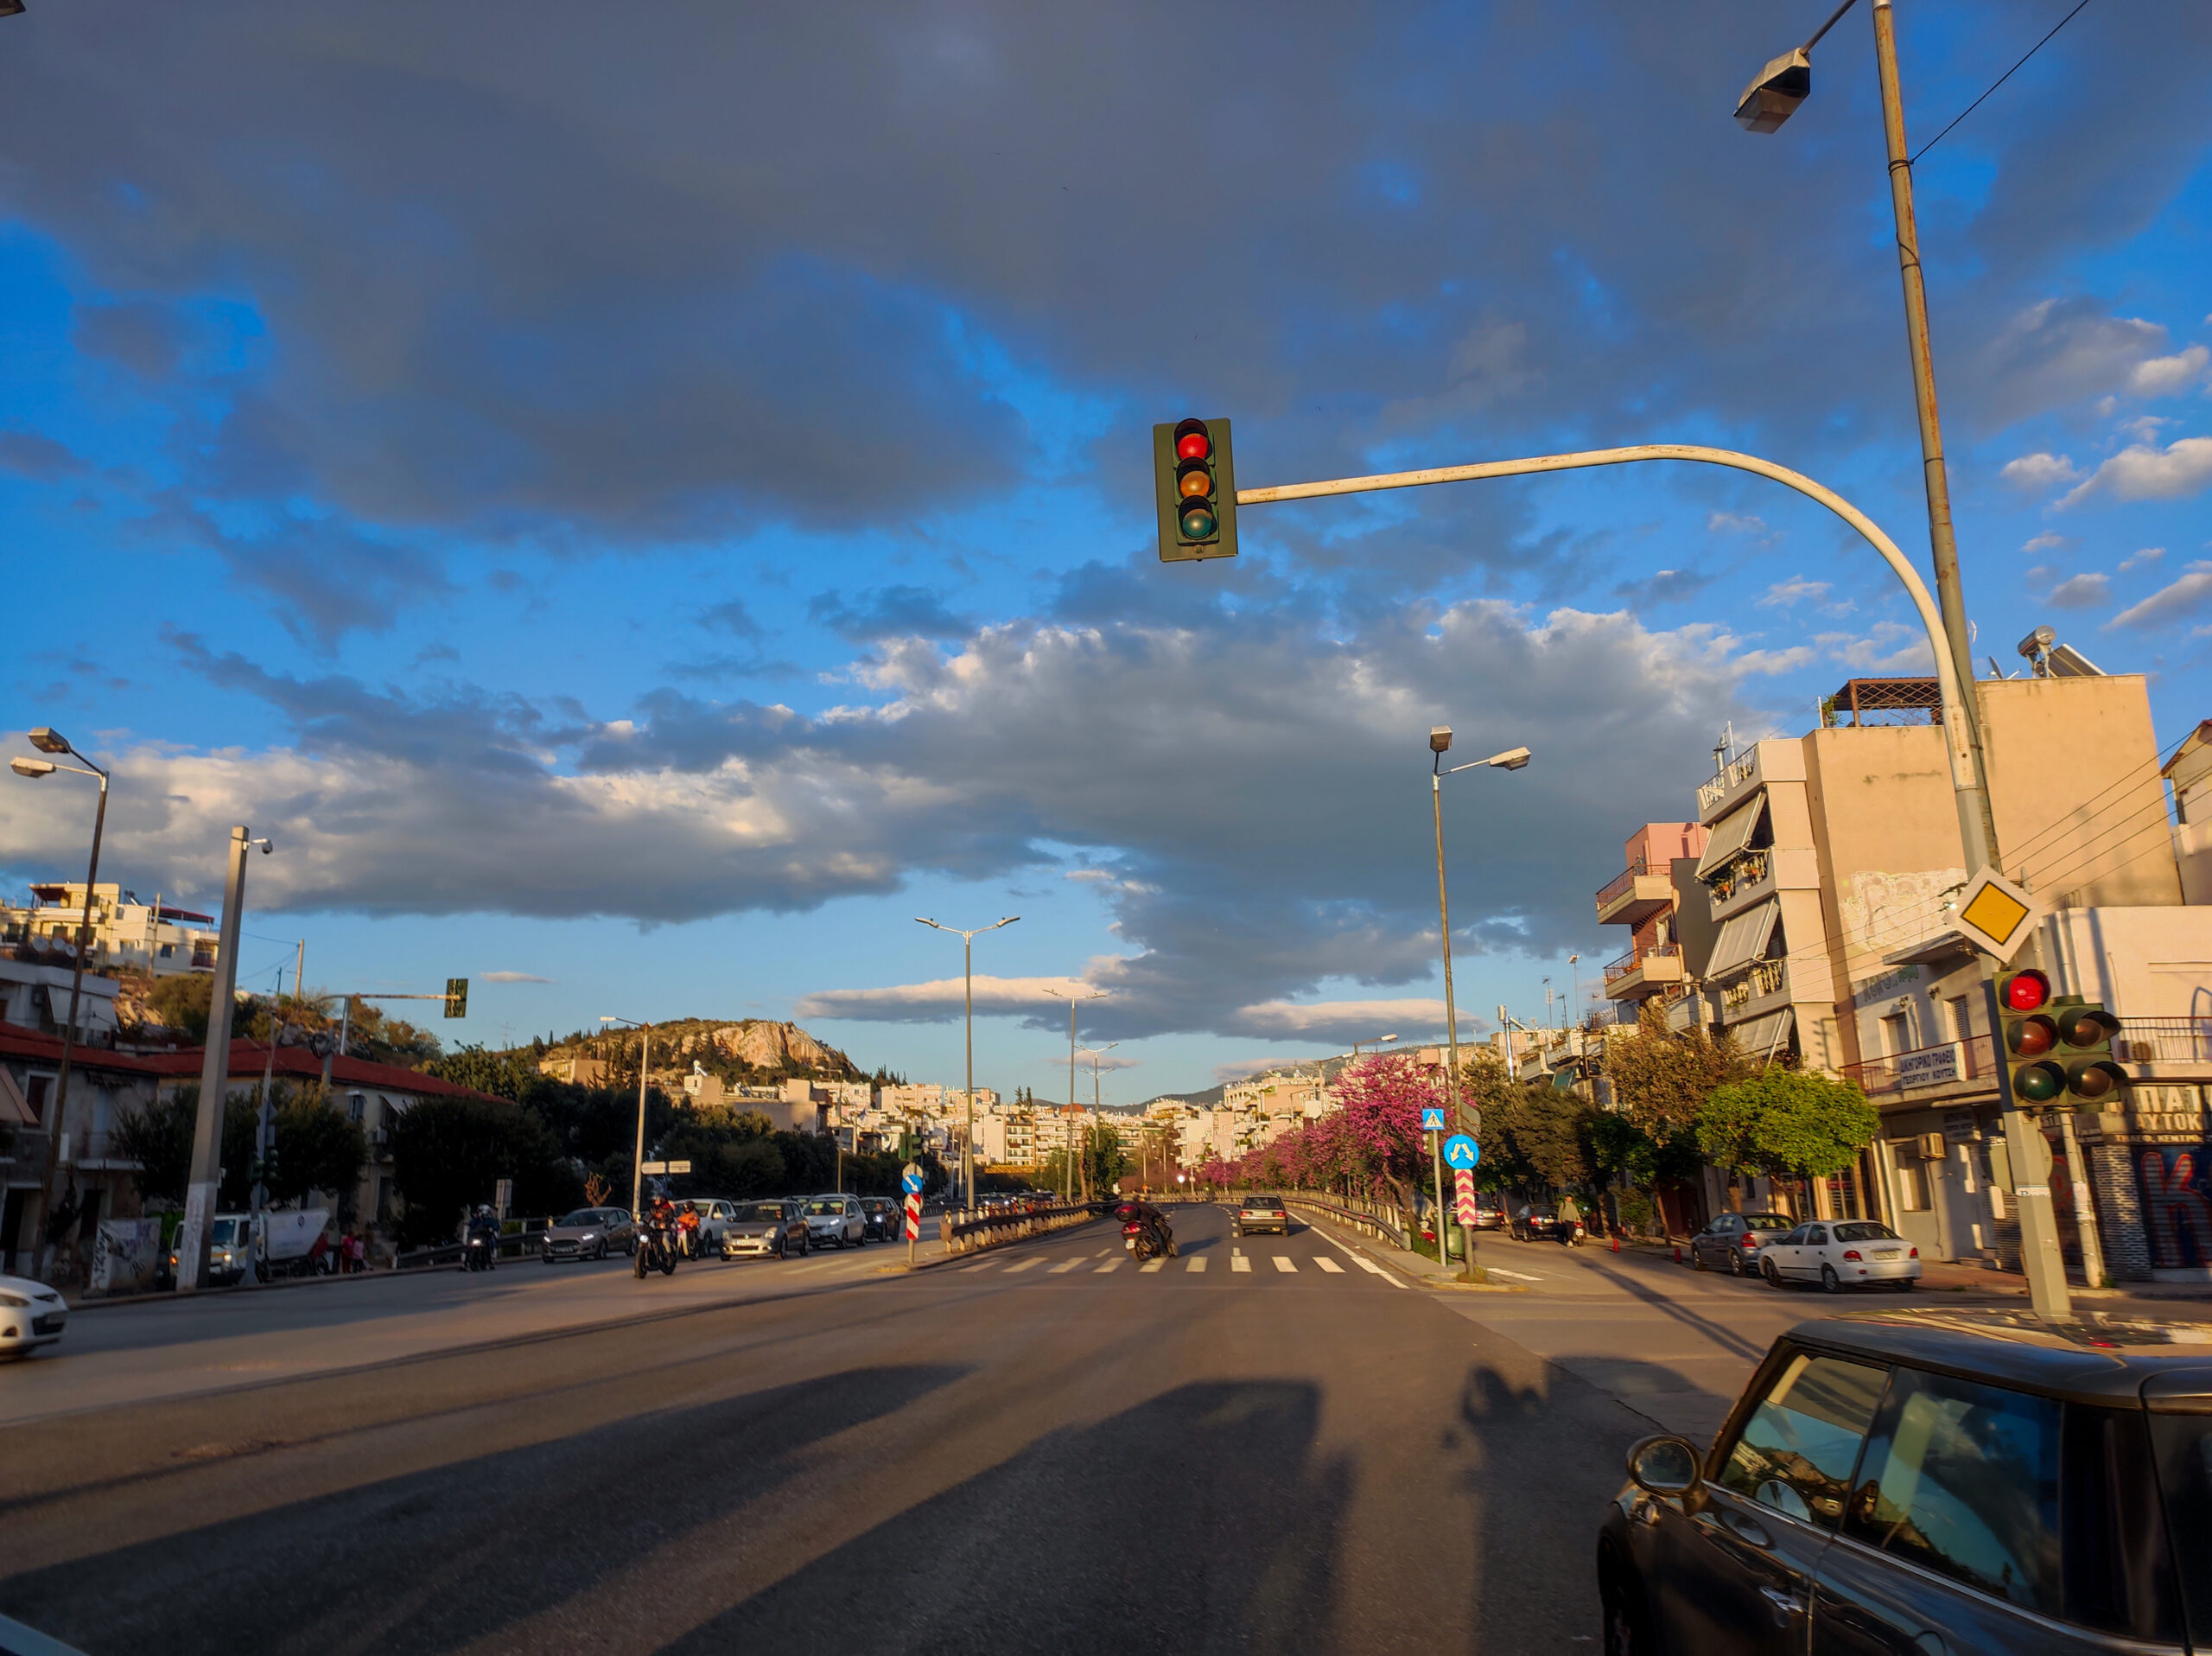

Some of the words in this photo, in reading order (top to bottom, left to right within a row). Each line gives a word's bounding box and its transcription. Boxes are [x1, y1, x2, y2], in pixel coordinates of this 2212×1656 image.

[1932, 1049, 1955, 1066] ΓΡΑΦΕΙΟ
[2138, 1086, 2212, 1113] ΠΑΤ
[2138, 1112, 2205, 1131] ΑΥΤΟΚ
